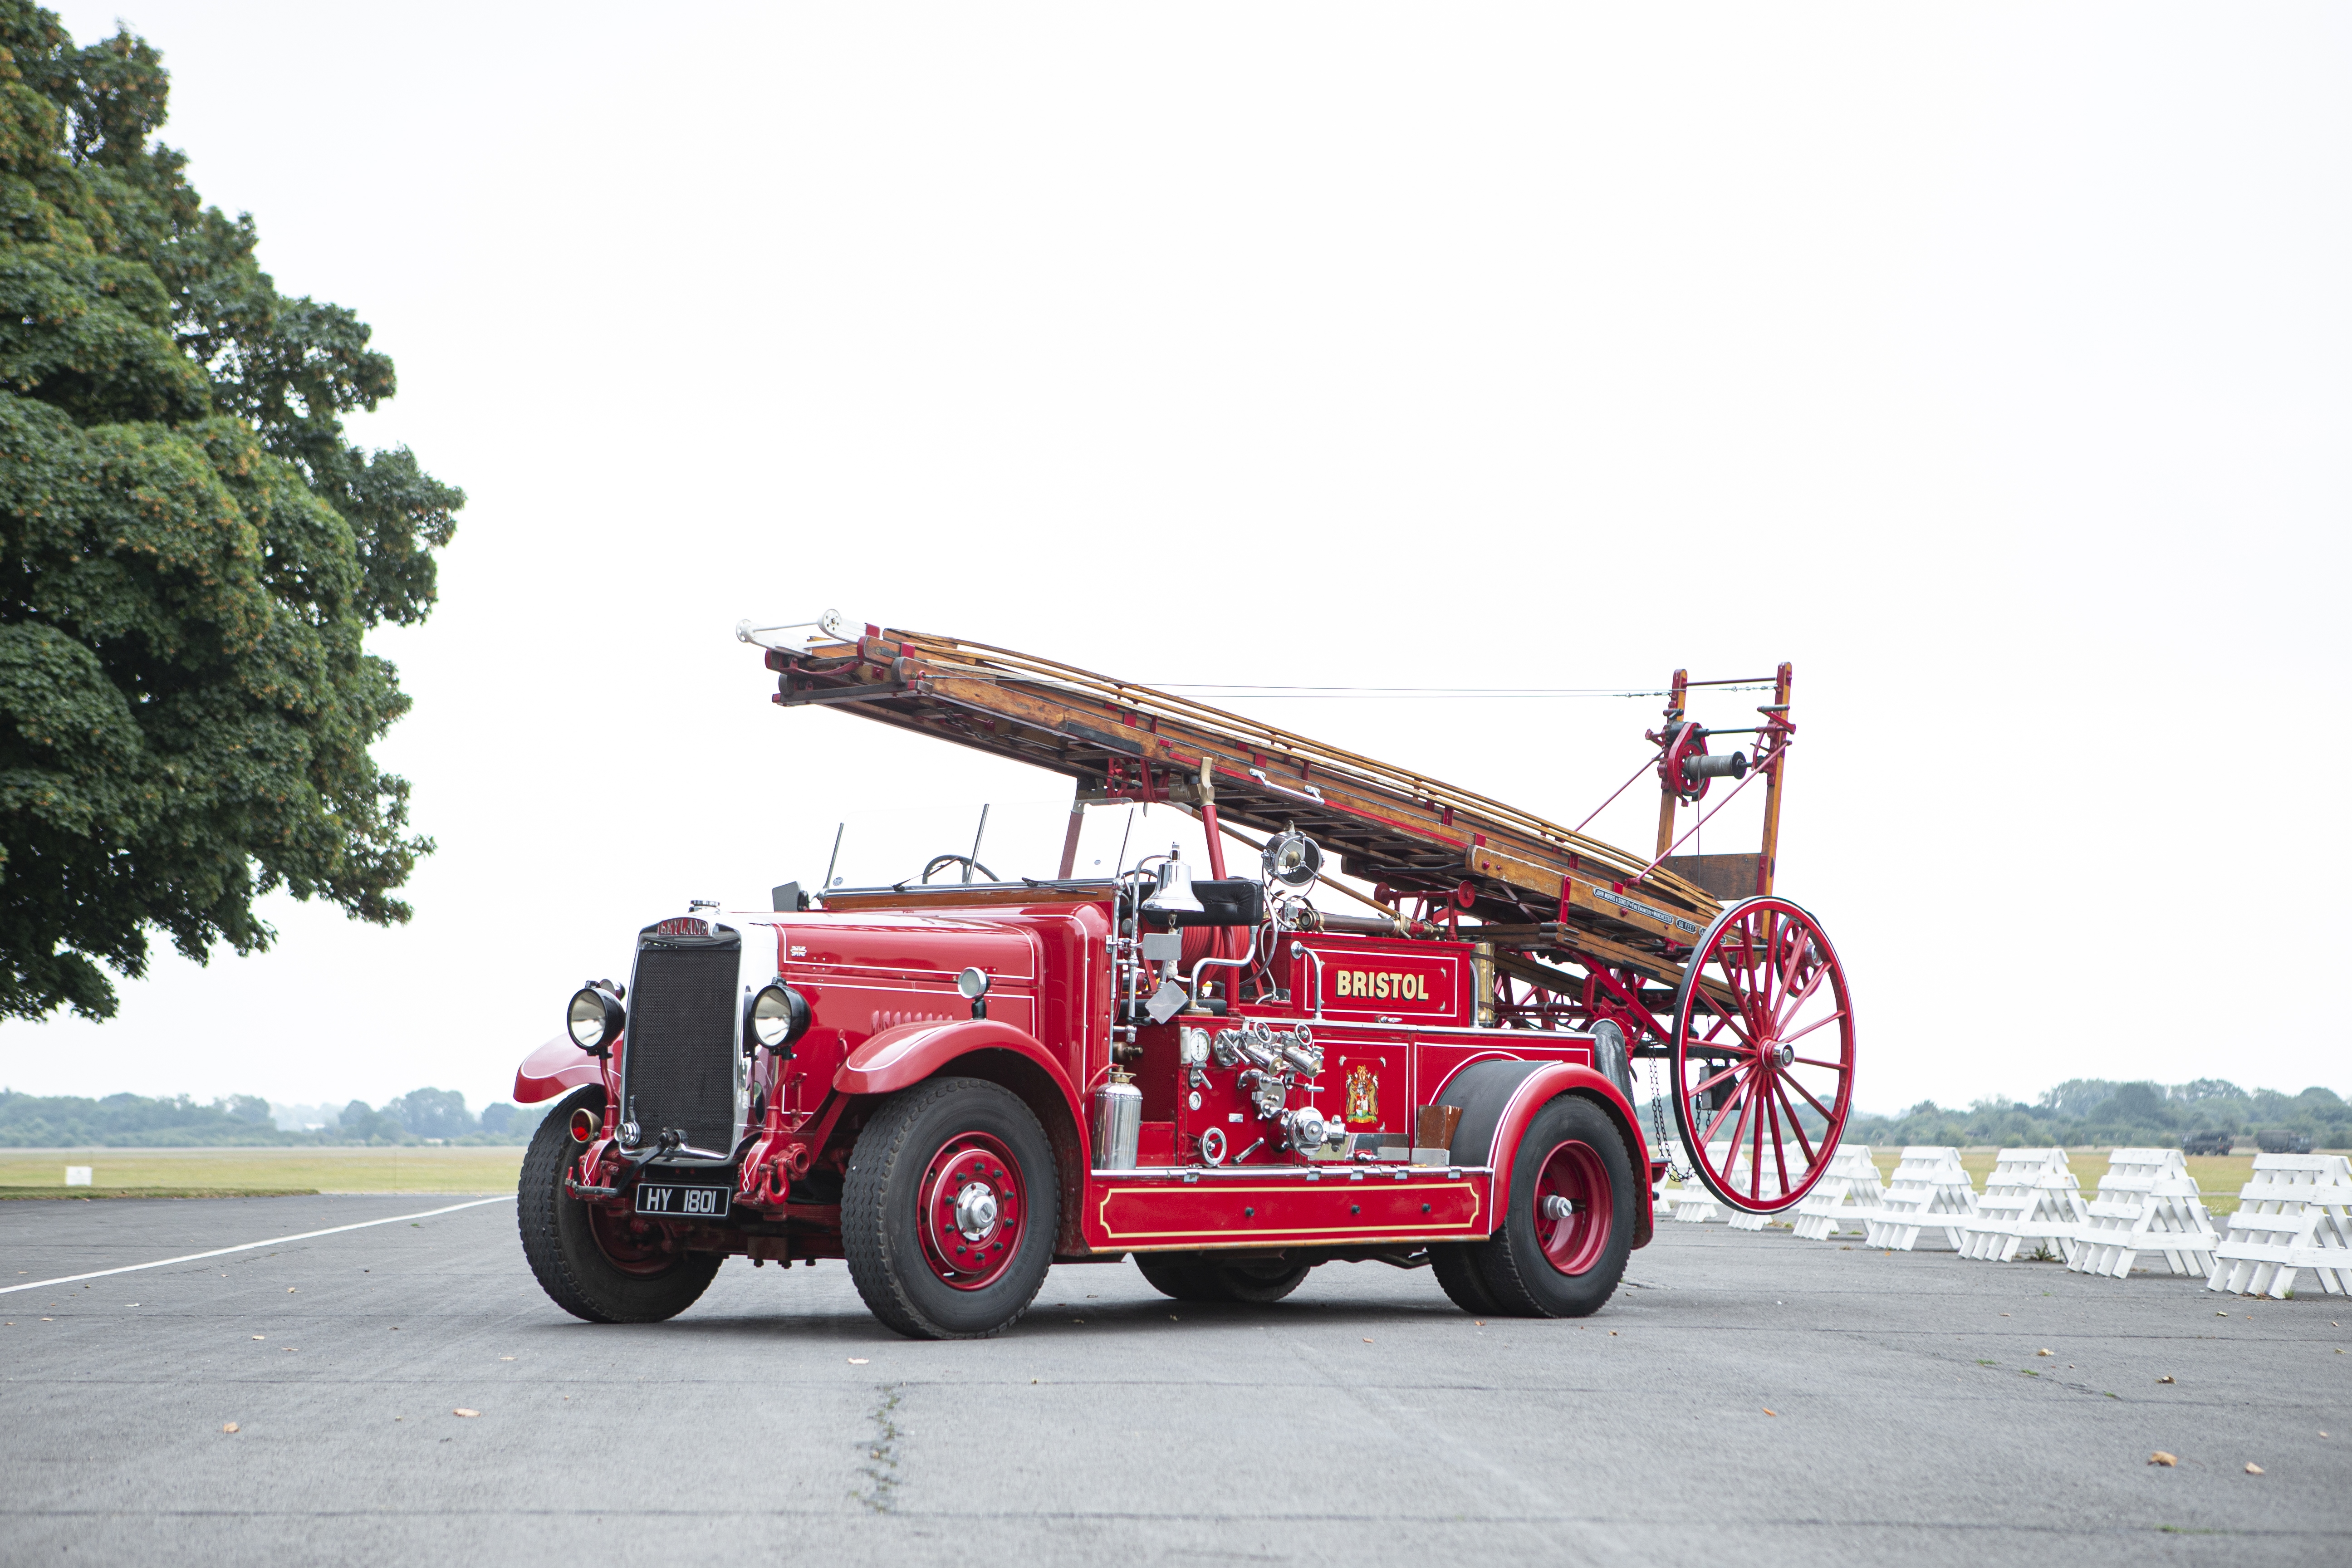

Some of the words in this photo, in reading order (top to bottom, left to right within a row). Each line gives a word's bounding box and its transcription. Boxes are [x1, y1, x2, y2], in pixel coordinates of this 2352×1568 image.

[1604, 892, 1616, 902] MORRIS
[1653, 911, 1671, 922] MANCHESTER
[661, 918, 708, 935] LEYLAND
[1685, 923, 1695, 931] FEET
[1336, 970, 1429, 1001] BRISTOL
[647, 1188, 672, 1211] HY
[683, 1189, 716, 1213] 1801
[990, 1215, 1041, 1301] UNIROYAL
